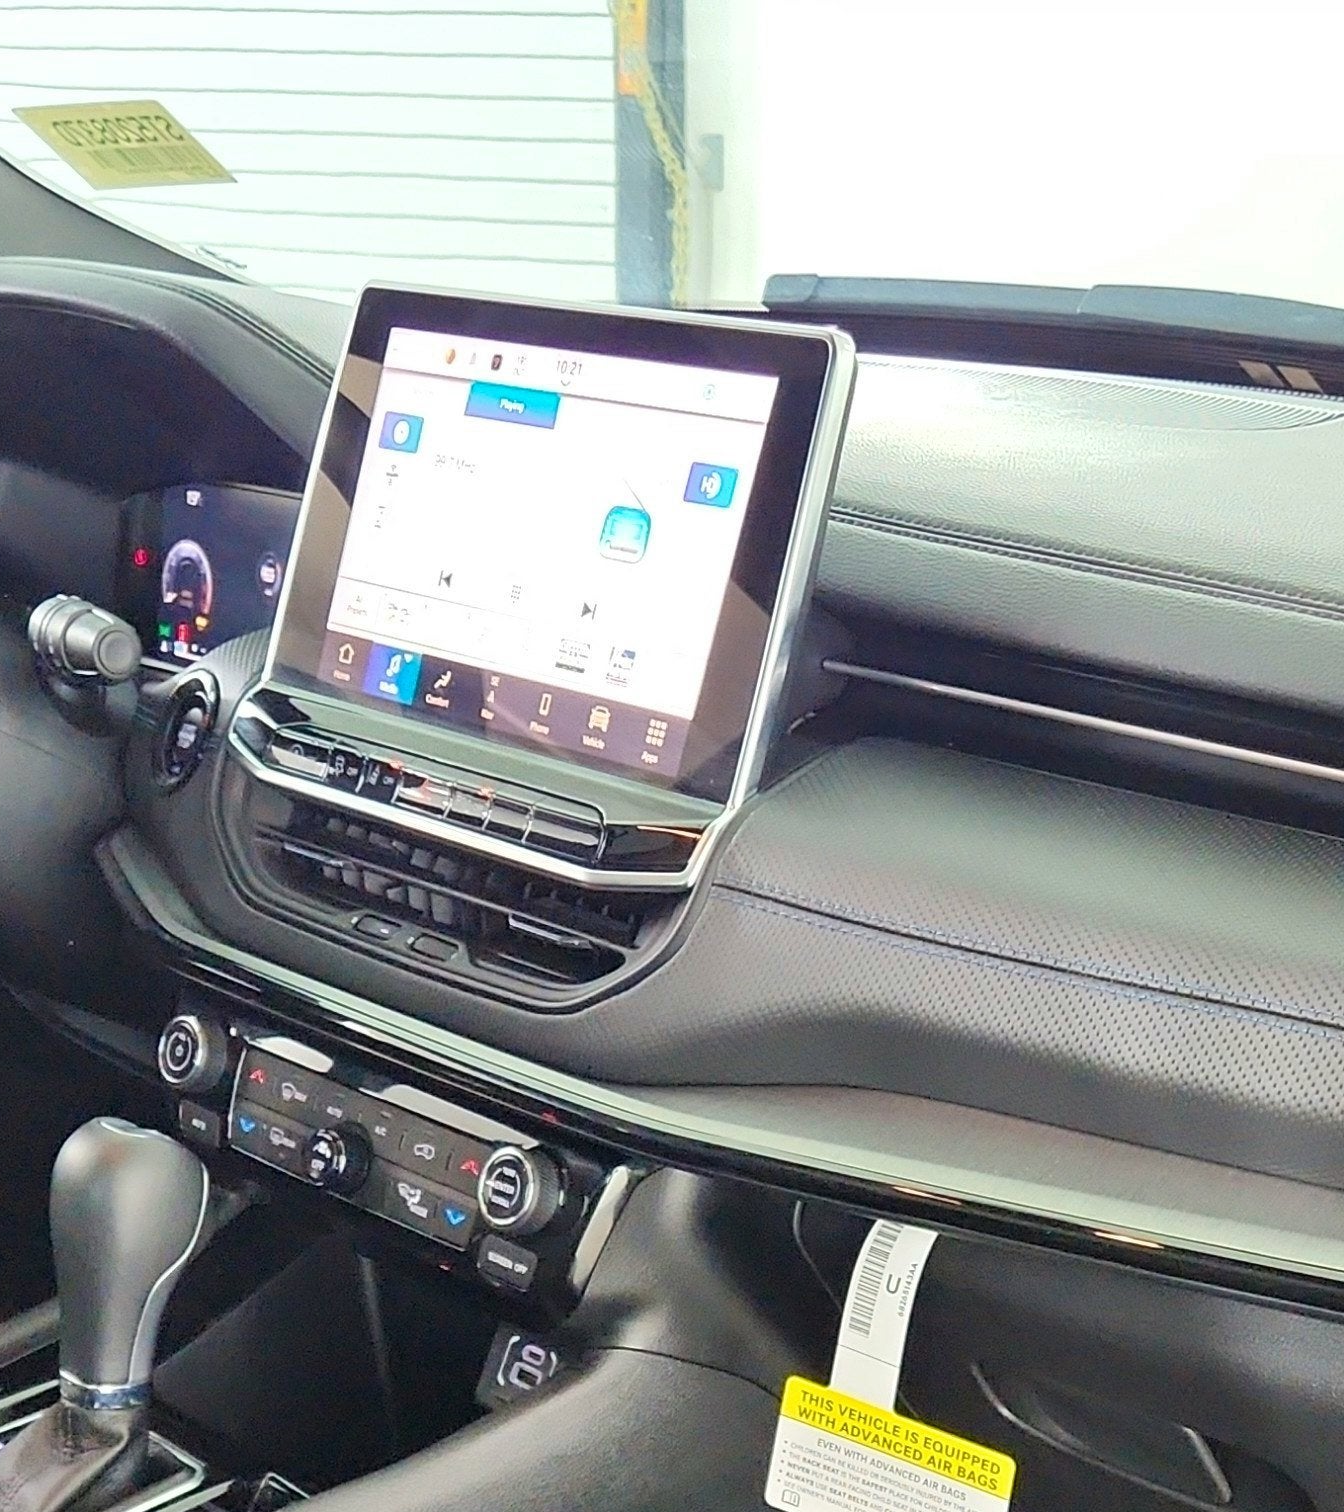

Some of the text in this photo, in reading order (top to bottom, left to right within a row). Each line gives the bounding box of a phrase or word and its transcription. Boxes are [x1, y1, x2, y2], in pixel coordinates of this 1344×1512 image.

[556, 360, 583, 376] 10:21
[886, 1273, 902, 1295] U
[798, 1406, 998, 1490] WITH ADVANCED AIR BAGS
[801, 1391, 1001, 1475] THIS VEHICLE IS EQUIPPED
[818, 1439, 966, 1501] EVEN WITH ADVANCED AIR BAGS
